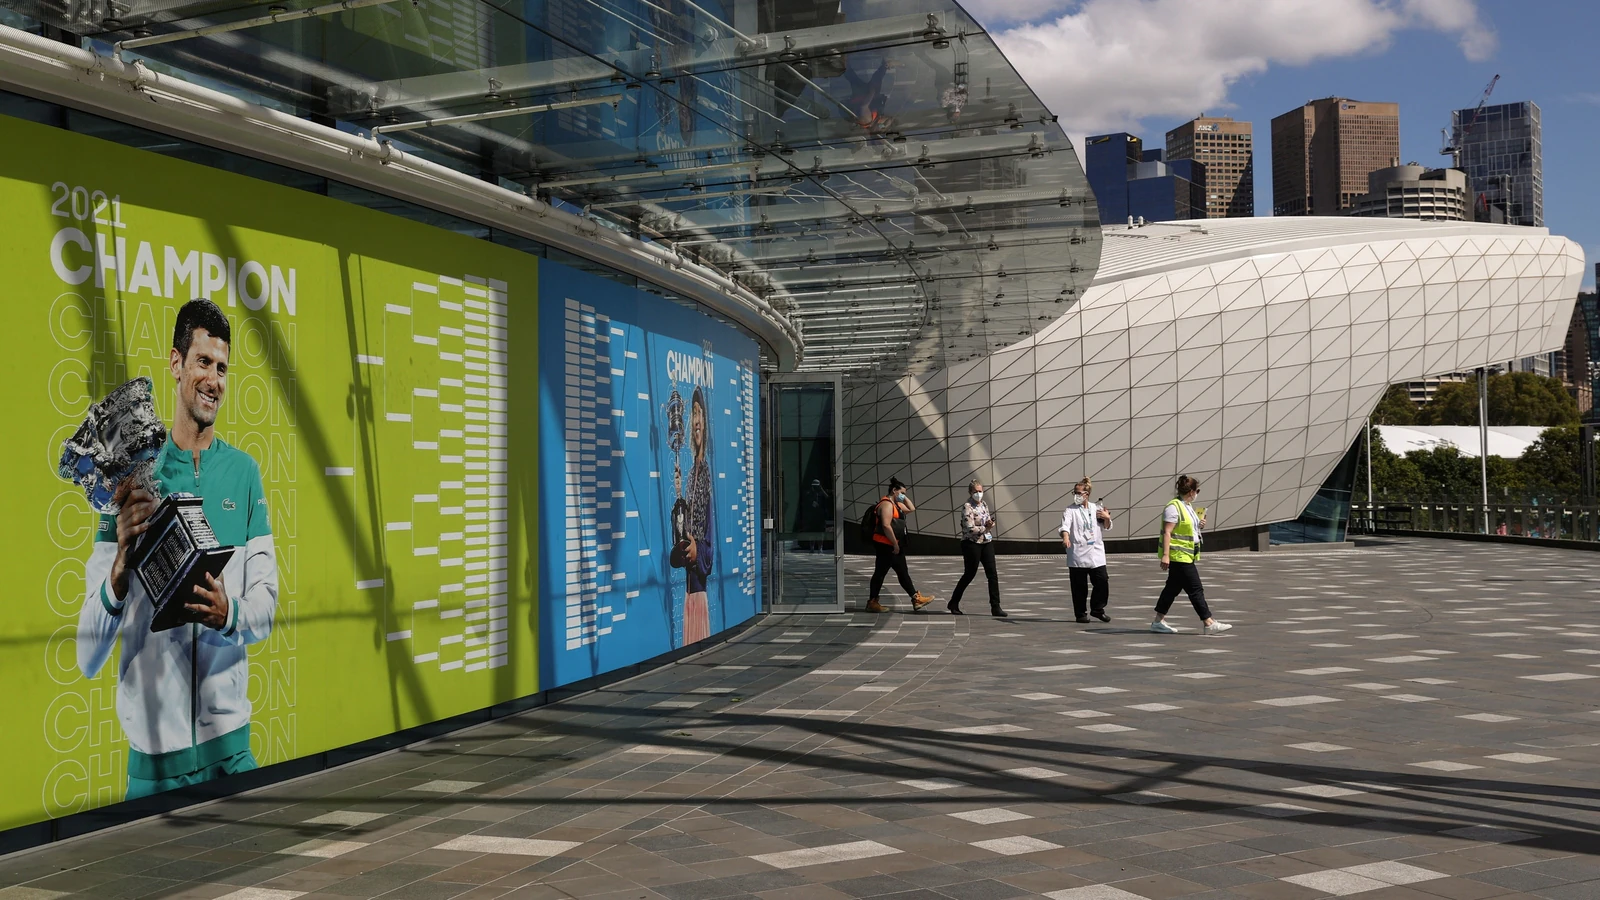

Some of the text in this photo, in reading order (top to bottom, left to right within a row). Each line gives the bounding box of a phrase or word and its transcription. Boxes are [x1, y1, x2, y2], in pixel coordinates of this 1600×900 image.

[51, 181, 127, 229] 2021
[50, 227, 297, 316] CHAMPION
[666, 350, 714, 389] CHAMPION
